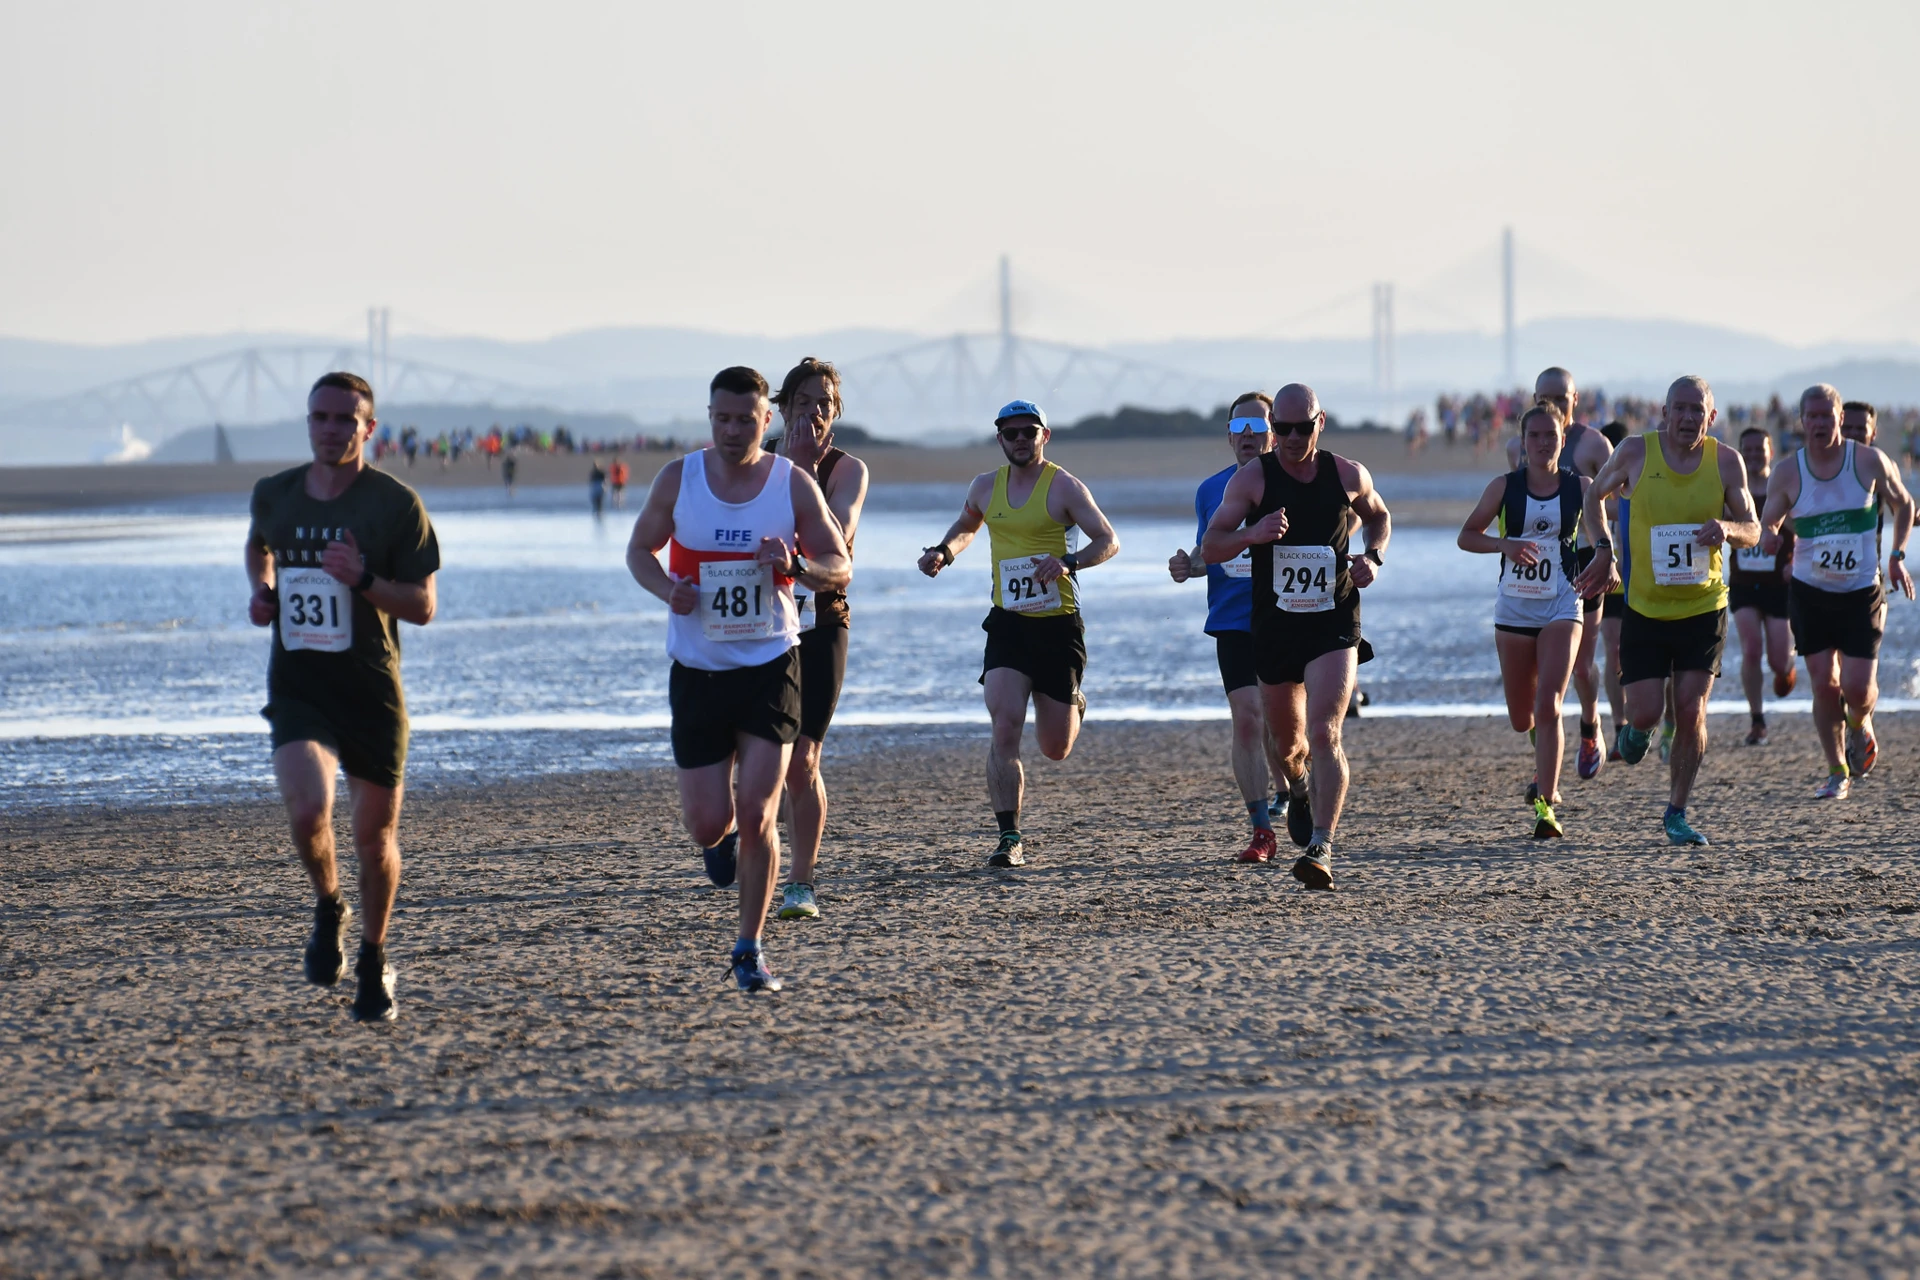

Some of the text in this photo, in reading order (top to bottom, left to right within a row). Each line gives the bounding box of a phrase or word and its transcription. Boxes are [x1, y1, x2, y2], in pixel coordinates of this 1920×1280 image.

[295, 527, 342, 541] NIKE
[715, 529, 752, 542] FIFE
[1280, 552, 1301, 560] BLACK
[1668, 543, 1693, 568] 51
[1820, 550, 1857, 571] 246
[311, 577, 332, 585] ROCK
[708, 569, 733, 577] BLACK
[735, 568, 757, 576] ROCK
[1282, 567, 1328, 593] 294
[1512, 558, 1552, 582] 480
[1008, 576, 1048, 601] 921
[289, 593, 338, 628] 331
[712, 585, 761, 618] 481
